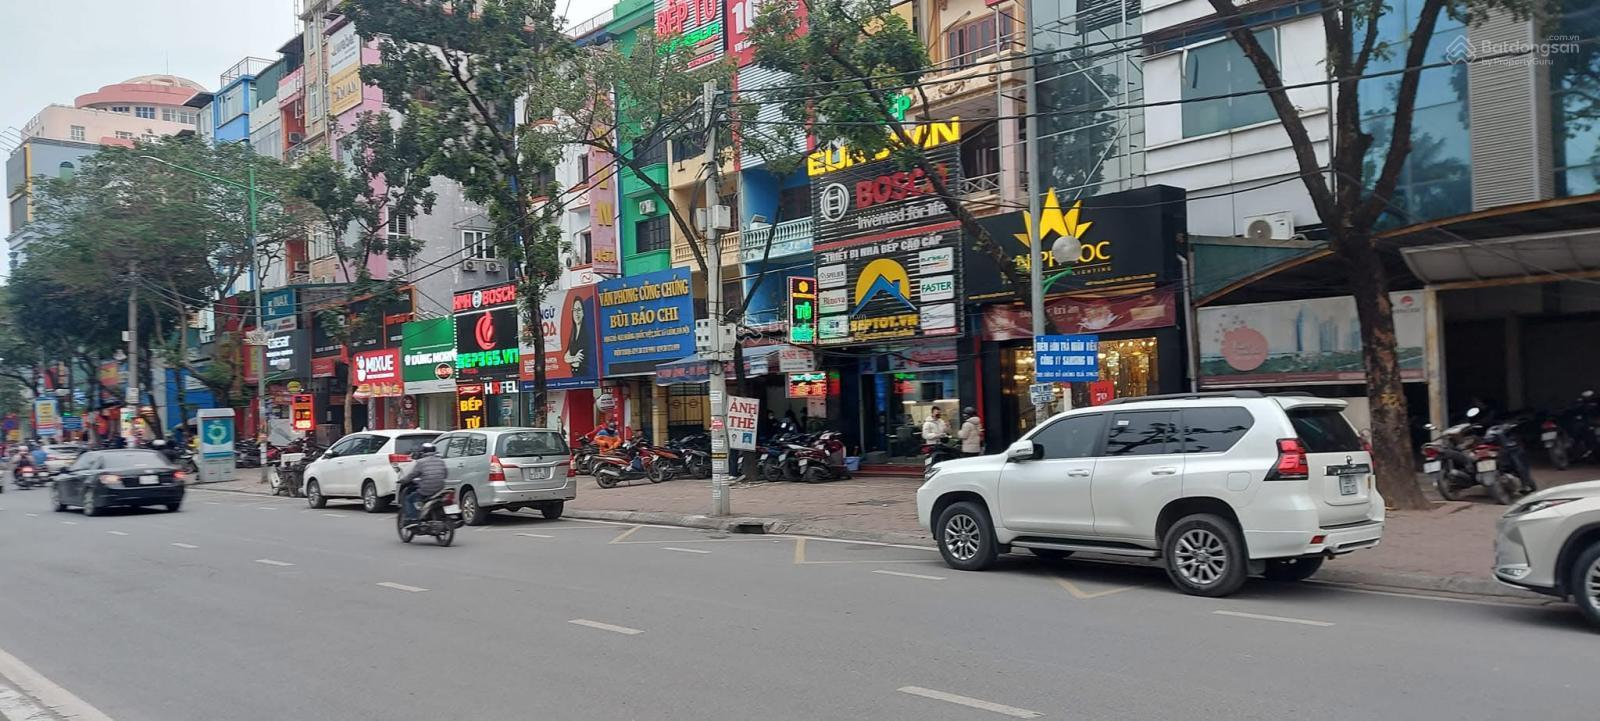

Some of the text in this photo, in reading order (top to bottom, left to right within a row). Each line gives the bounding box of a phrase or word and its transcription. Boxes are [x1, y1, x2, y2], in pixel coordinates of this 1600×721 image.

[857, 201, 948, 229] Invented for life
[921, 281, 952, 294] FASTER
[609, 305, 680, 328] BÙI BẢO CHI
[365, 354, 394, 373] MIXUE
[460, 396, 483, 412] BẾP
[729, 397, 757, 415] ẢNH
[465, 415, 480, 429] TỪ
[728, 414, 756, 429] THẺ
